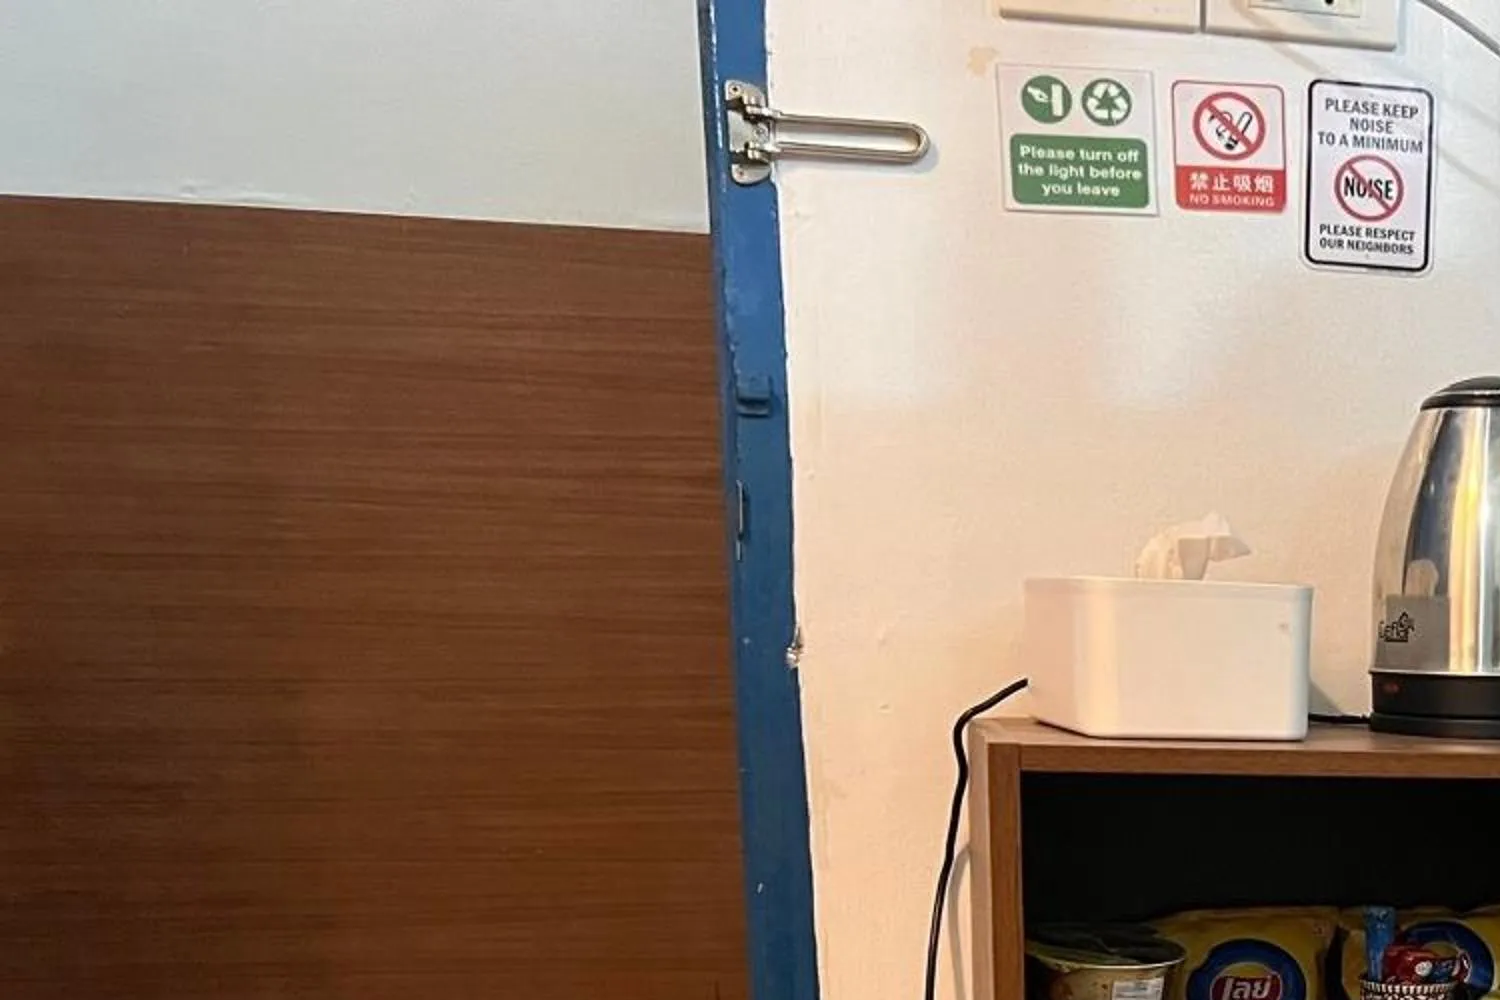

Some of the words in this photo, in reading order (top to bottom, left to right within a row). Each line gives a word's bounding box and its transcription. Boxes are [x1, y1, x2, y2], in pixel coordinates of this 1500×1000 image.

[1325, 98, 1379, 116] PLEASE
[1383, 103, 1418, 119] KEEP
[1349, 118, 1394, 134] NOISE
[1318, 131, 1336, 145] TO
[1339, 133, 1348, 147] A
[1352, 135, 1423, 153] MINIMUM
[1020, 144, 1075, 160] Please
[1080, 148, 1113, 161] turn
[1117, 149, 1139, 162] off
[1018, 163, 1044, 176] the
[1049, 164, 1084, 180] light
[1089, 165, 1142, 180] before
[1041, 183, 1072, 197] you
[1077, 182, 1120, 196] leave
[1190, 171, 1274, 193] 禁止吸烟
[1344, 176, 1393, 200] NOISE
[1189, 193, 1209, 205] NO
[1211, 194, 1275, 207] SMOKING
[1319, 223, 1362, 238] PLEASE
[1365, 226, 1415, 241] RESPECT
[1319, 237, 1344, 249] OUR
[1346, 239, 1414, 254] NEIGHBORS
